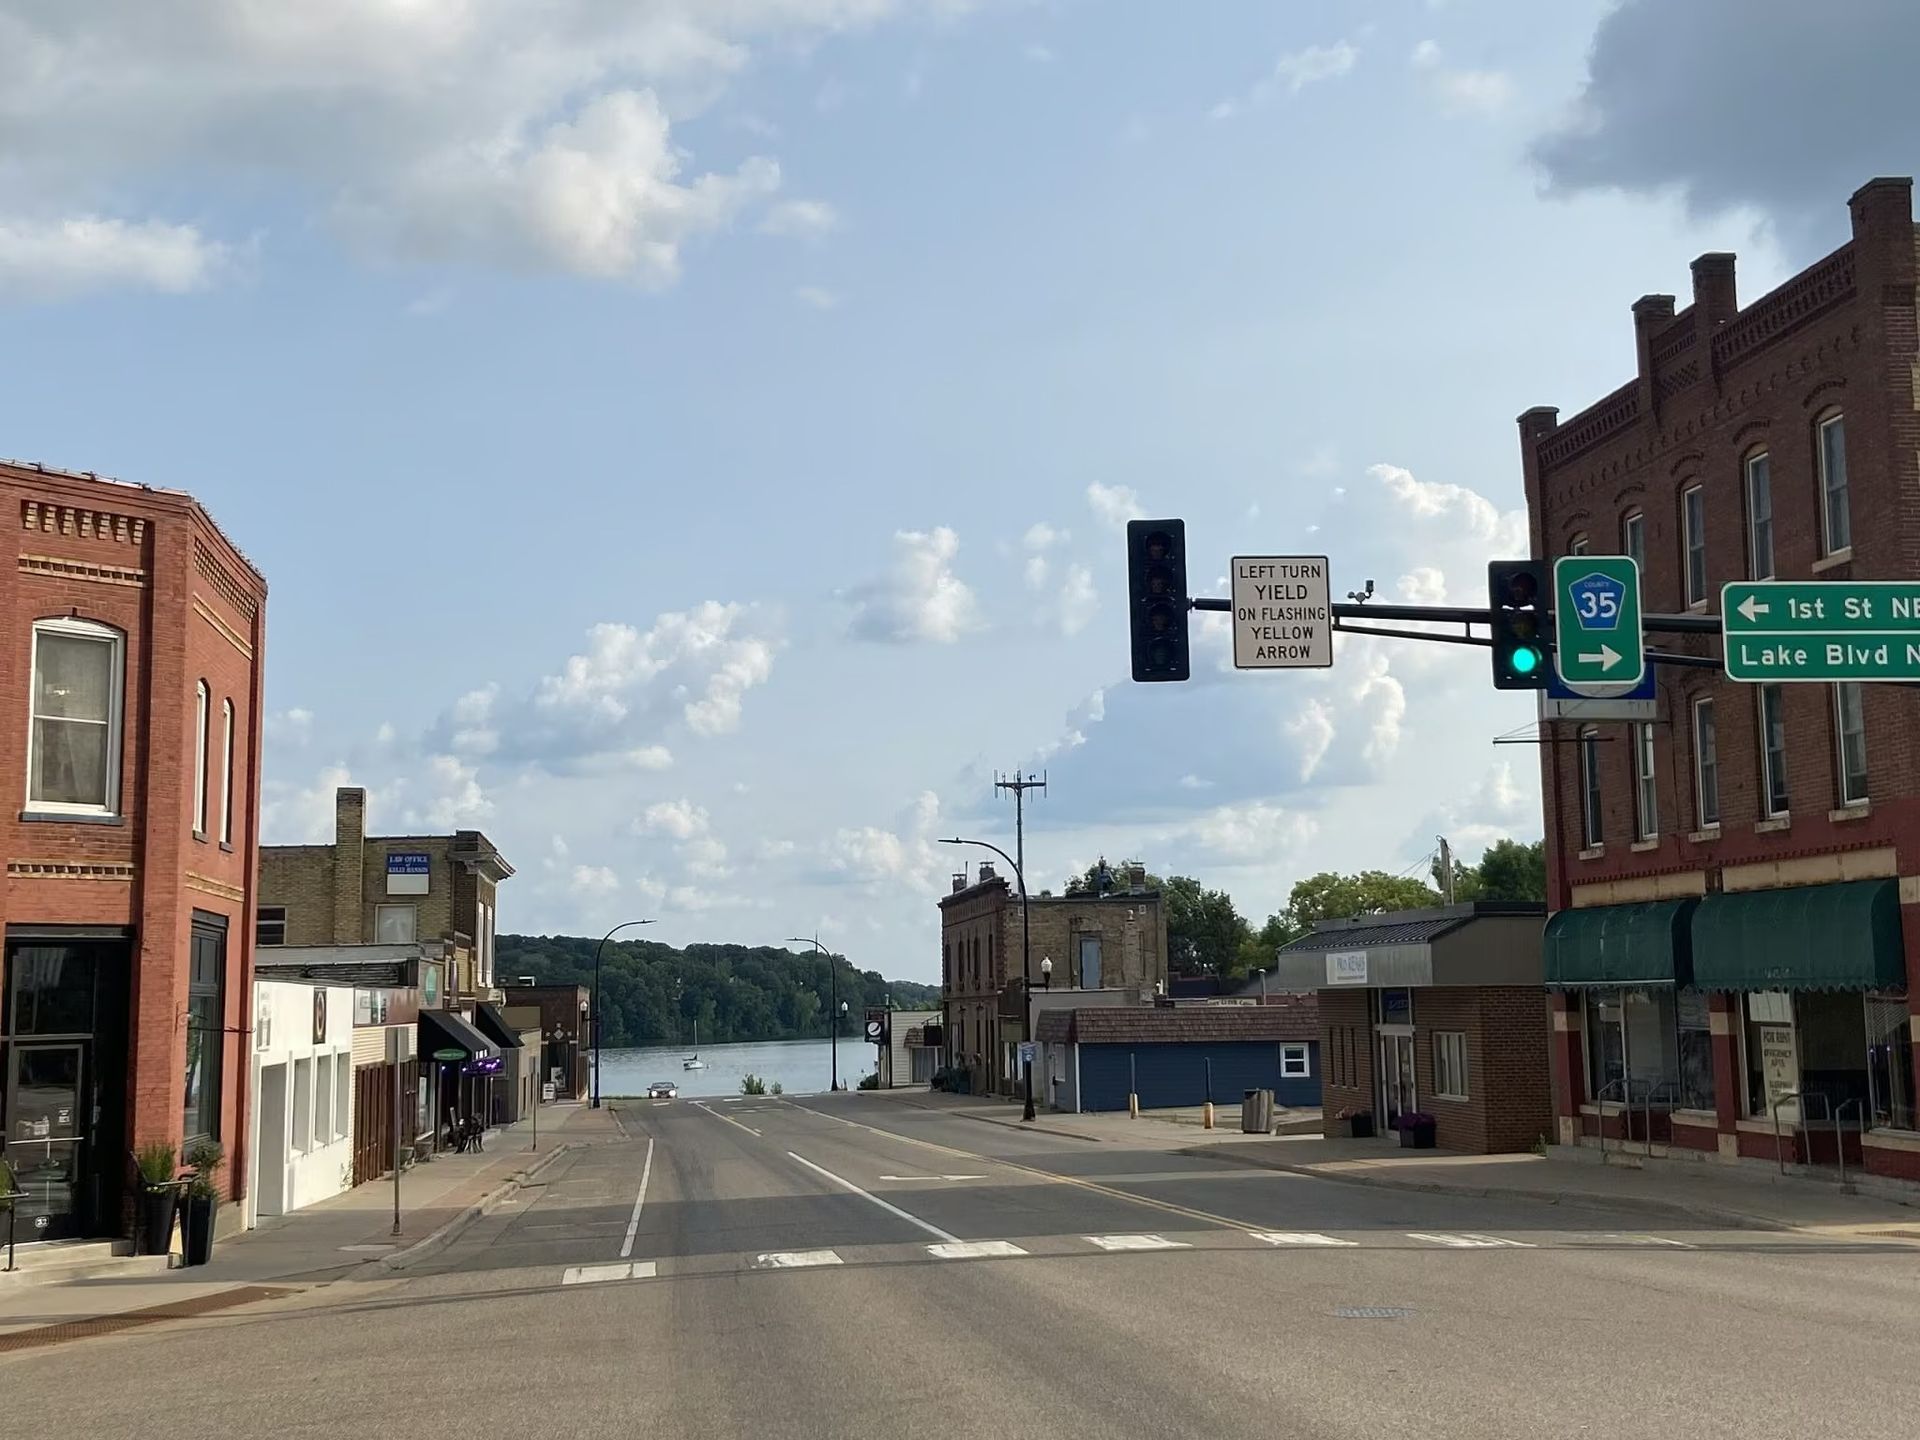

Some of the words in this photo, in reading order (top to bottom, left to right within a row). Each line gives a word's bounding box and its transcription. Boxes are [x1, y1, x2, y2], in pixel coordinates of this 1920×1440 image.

[1240, 565, 1275, 579] LEFT
[1280, 565, 1321, 579] TURN
[1254, 584, 1308, 600] YIELD
[1580, 591, 1617, 618] 35
[1788, 598, 1824, 619] 1st
[1844, 597, 1872, 619] St
[1238, 607, 1256, 621] ON
[1261, 607, 1326, 620] FLASHING
[1250, 626, 1314, 640] YELLOW
[1256, 645, 1311, 659] ARROW
[1741, 644, 1807, 665] Lake
[1826, 644, 1888, 665] Blvd
